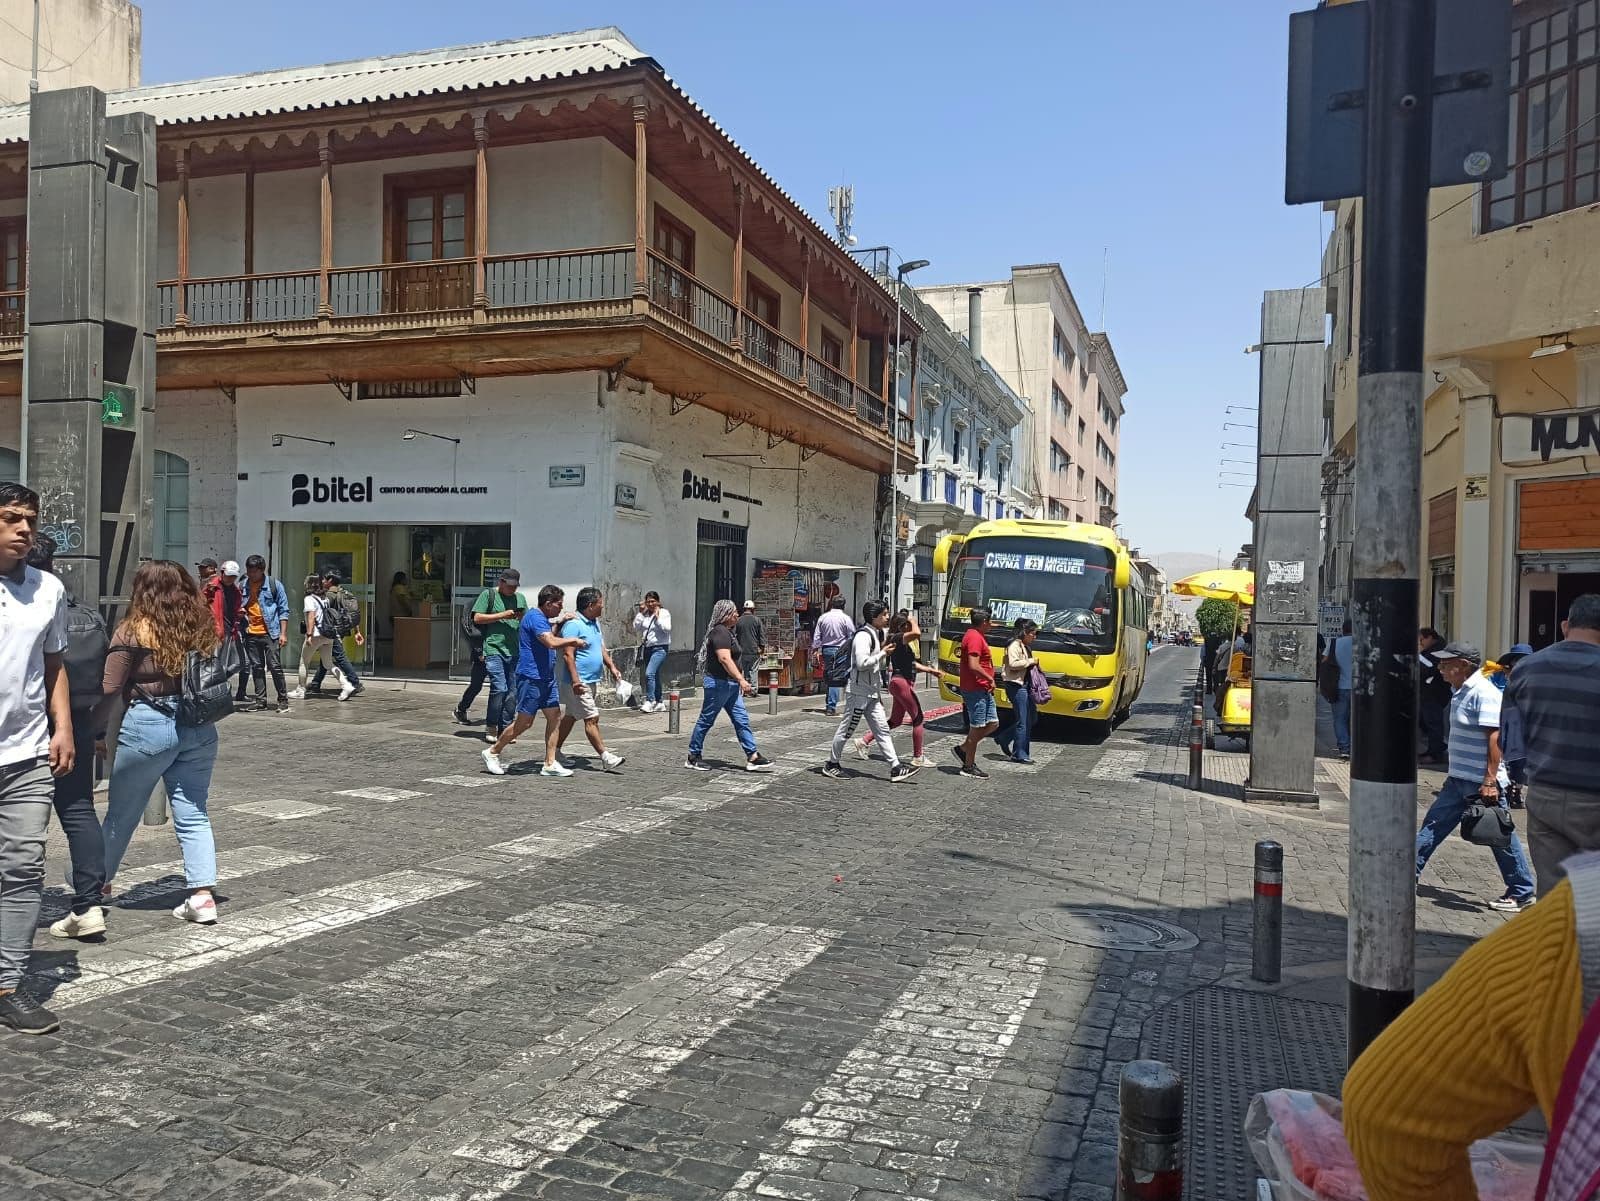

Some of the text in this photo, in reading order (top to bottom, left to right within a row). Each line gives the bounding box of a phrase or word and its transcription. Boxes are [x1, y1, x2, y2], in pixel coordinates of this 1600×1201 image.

[313, 476, 373, 502] bitel
[379, 485, 488, 494] CENTRO DE ATENCIÓN AL CLIENTE
[692, 475, 721, 504] bitel
[985, 552, 1020, 570] CAYMA
[1043, 562, 1085, 575] MIGUEL
